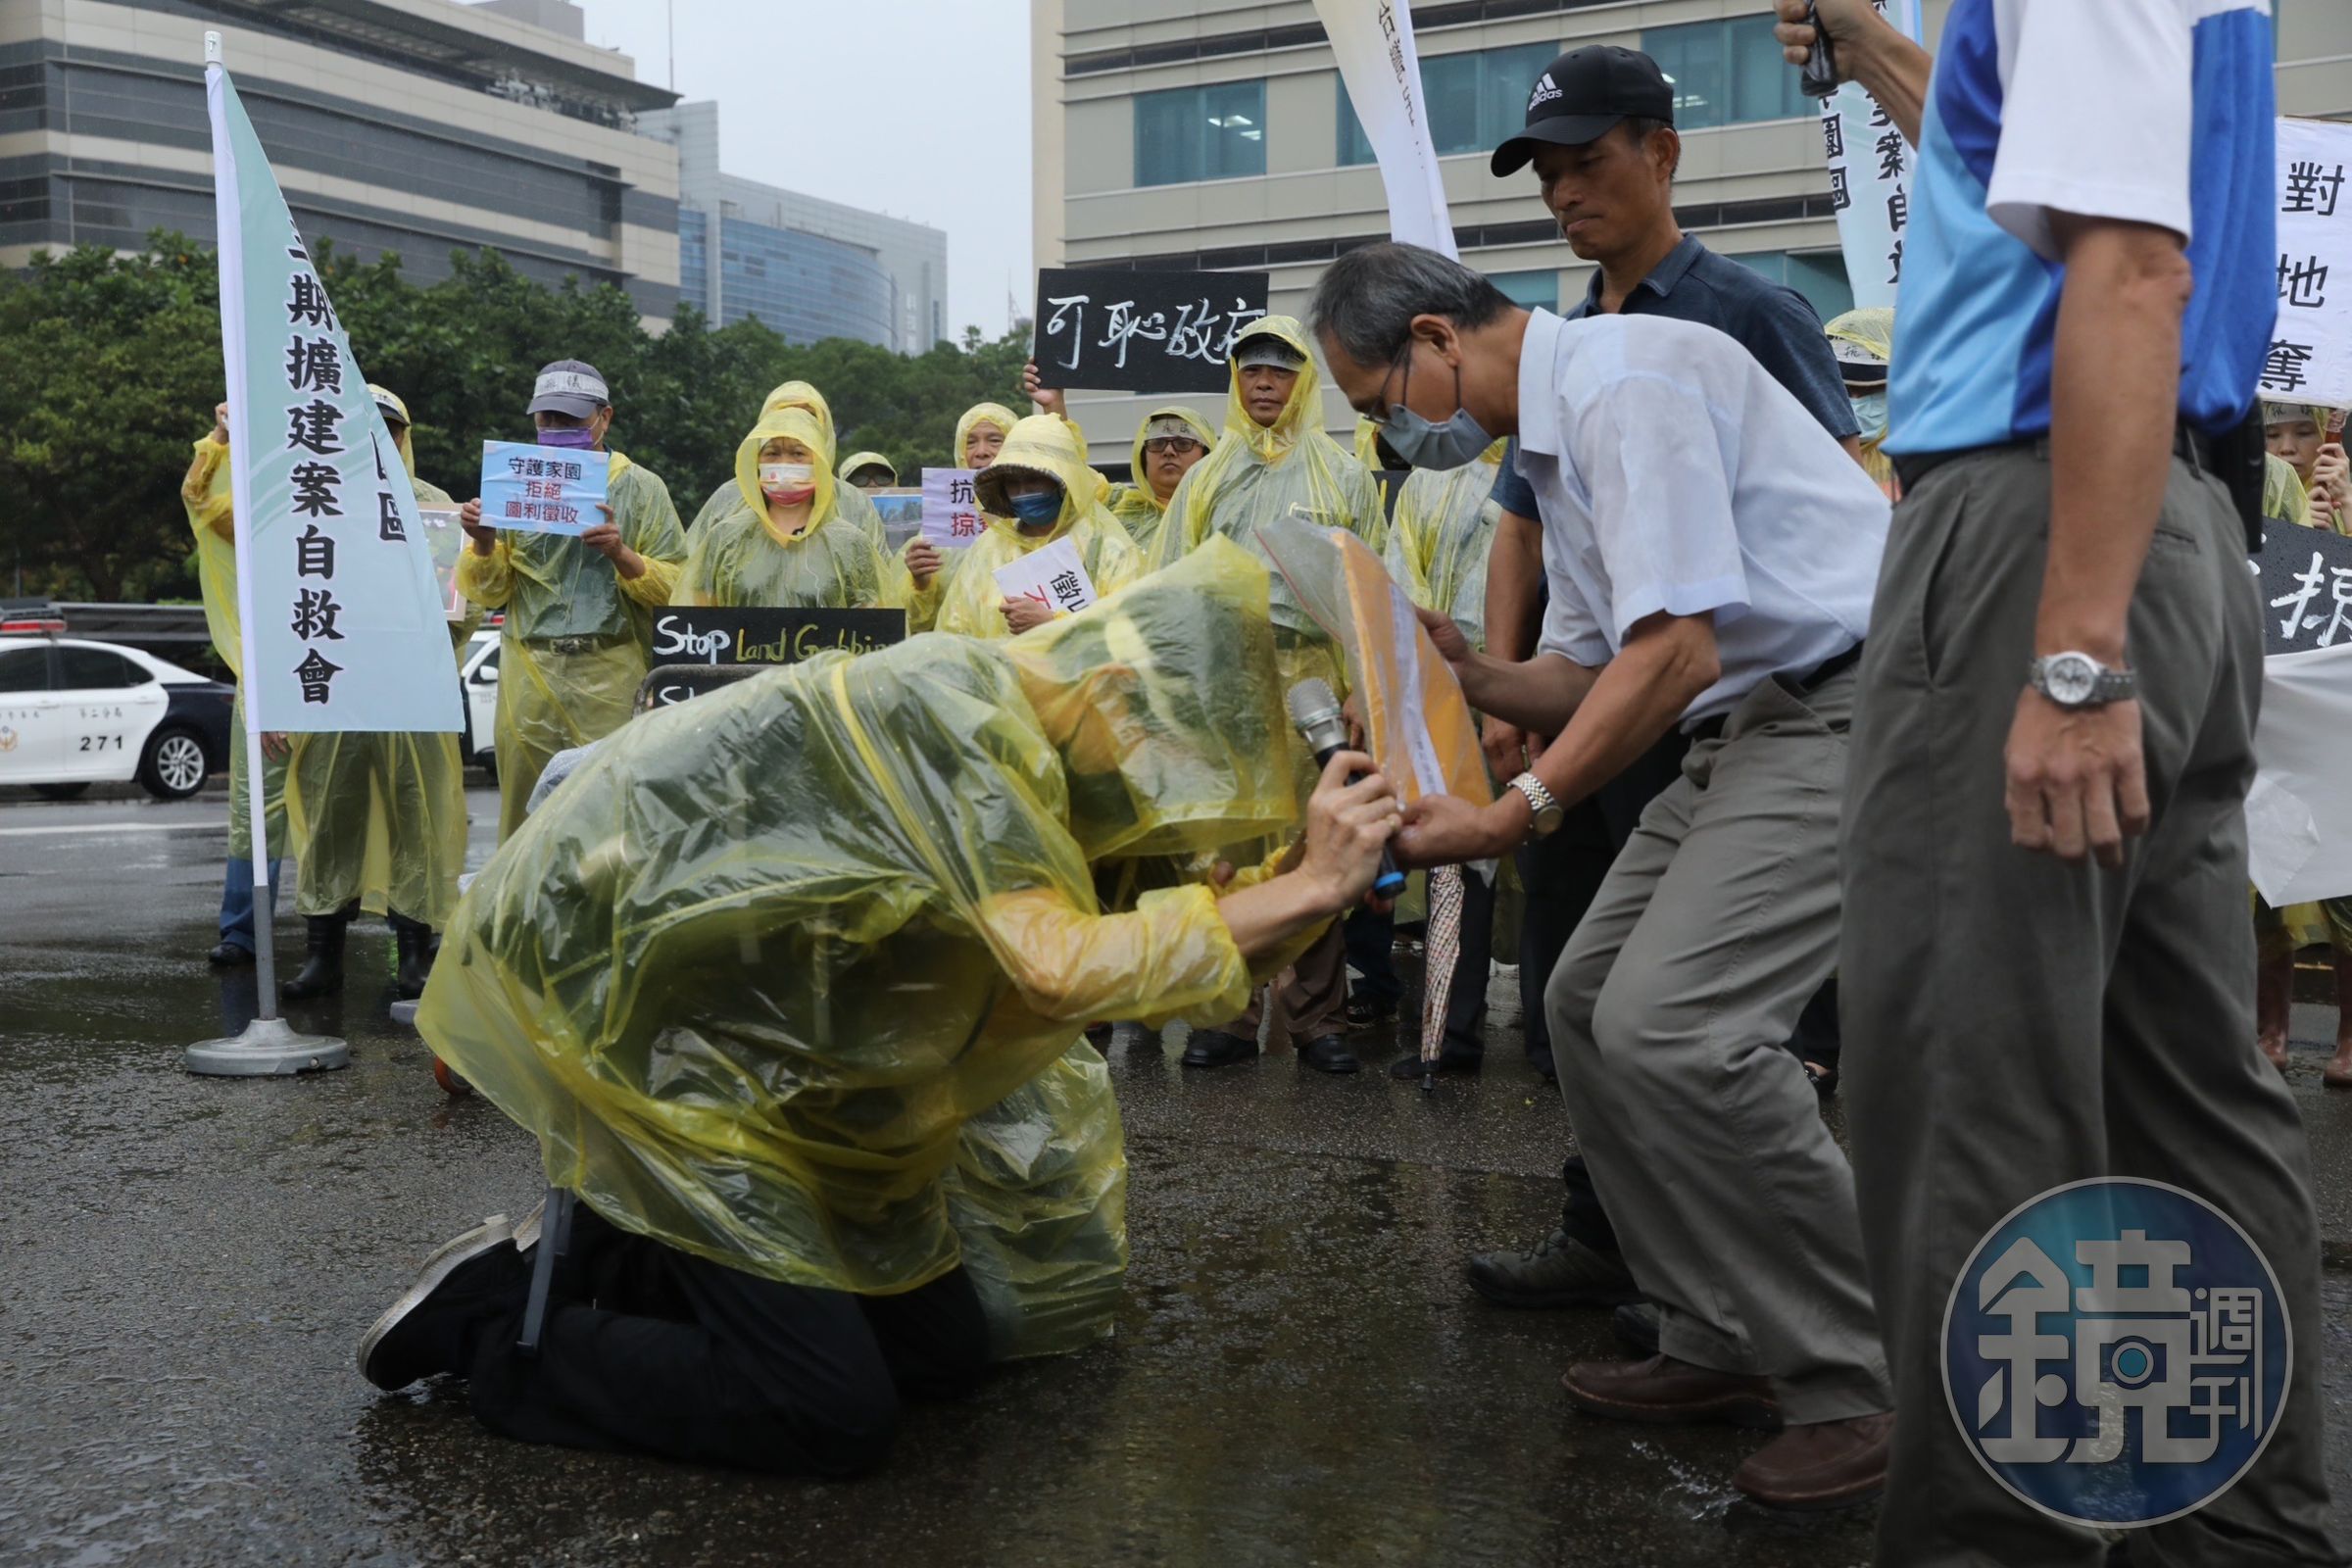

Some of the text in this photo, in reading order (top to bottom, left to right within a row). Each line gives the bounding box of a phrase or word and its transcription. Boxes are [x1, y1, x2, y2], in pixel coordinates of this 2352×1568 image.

[508, 457, 581, 480] 守護家園
[525, 481, 563, 501] 拒絕
[653, 615, 731, 665] Stop
[735, 627, 787, 662] Land
[79, 735, 122, 752] 271
